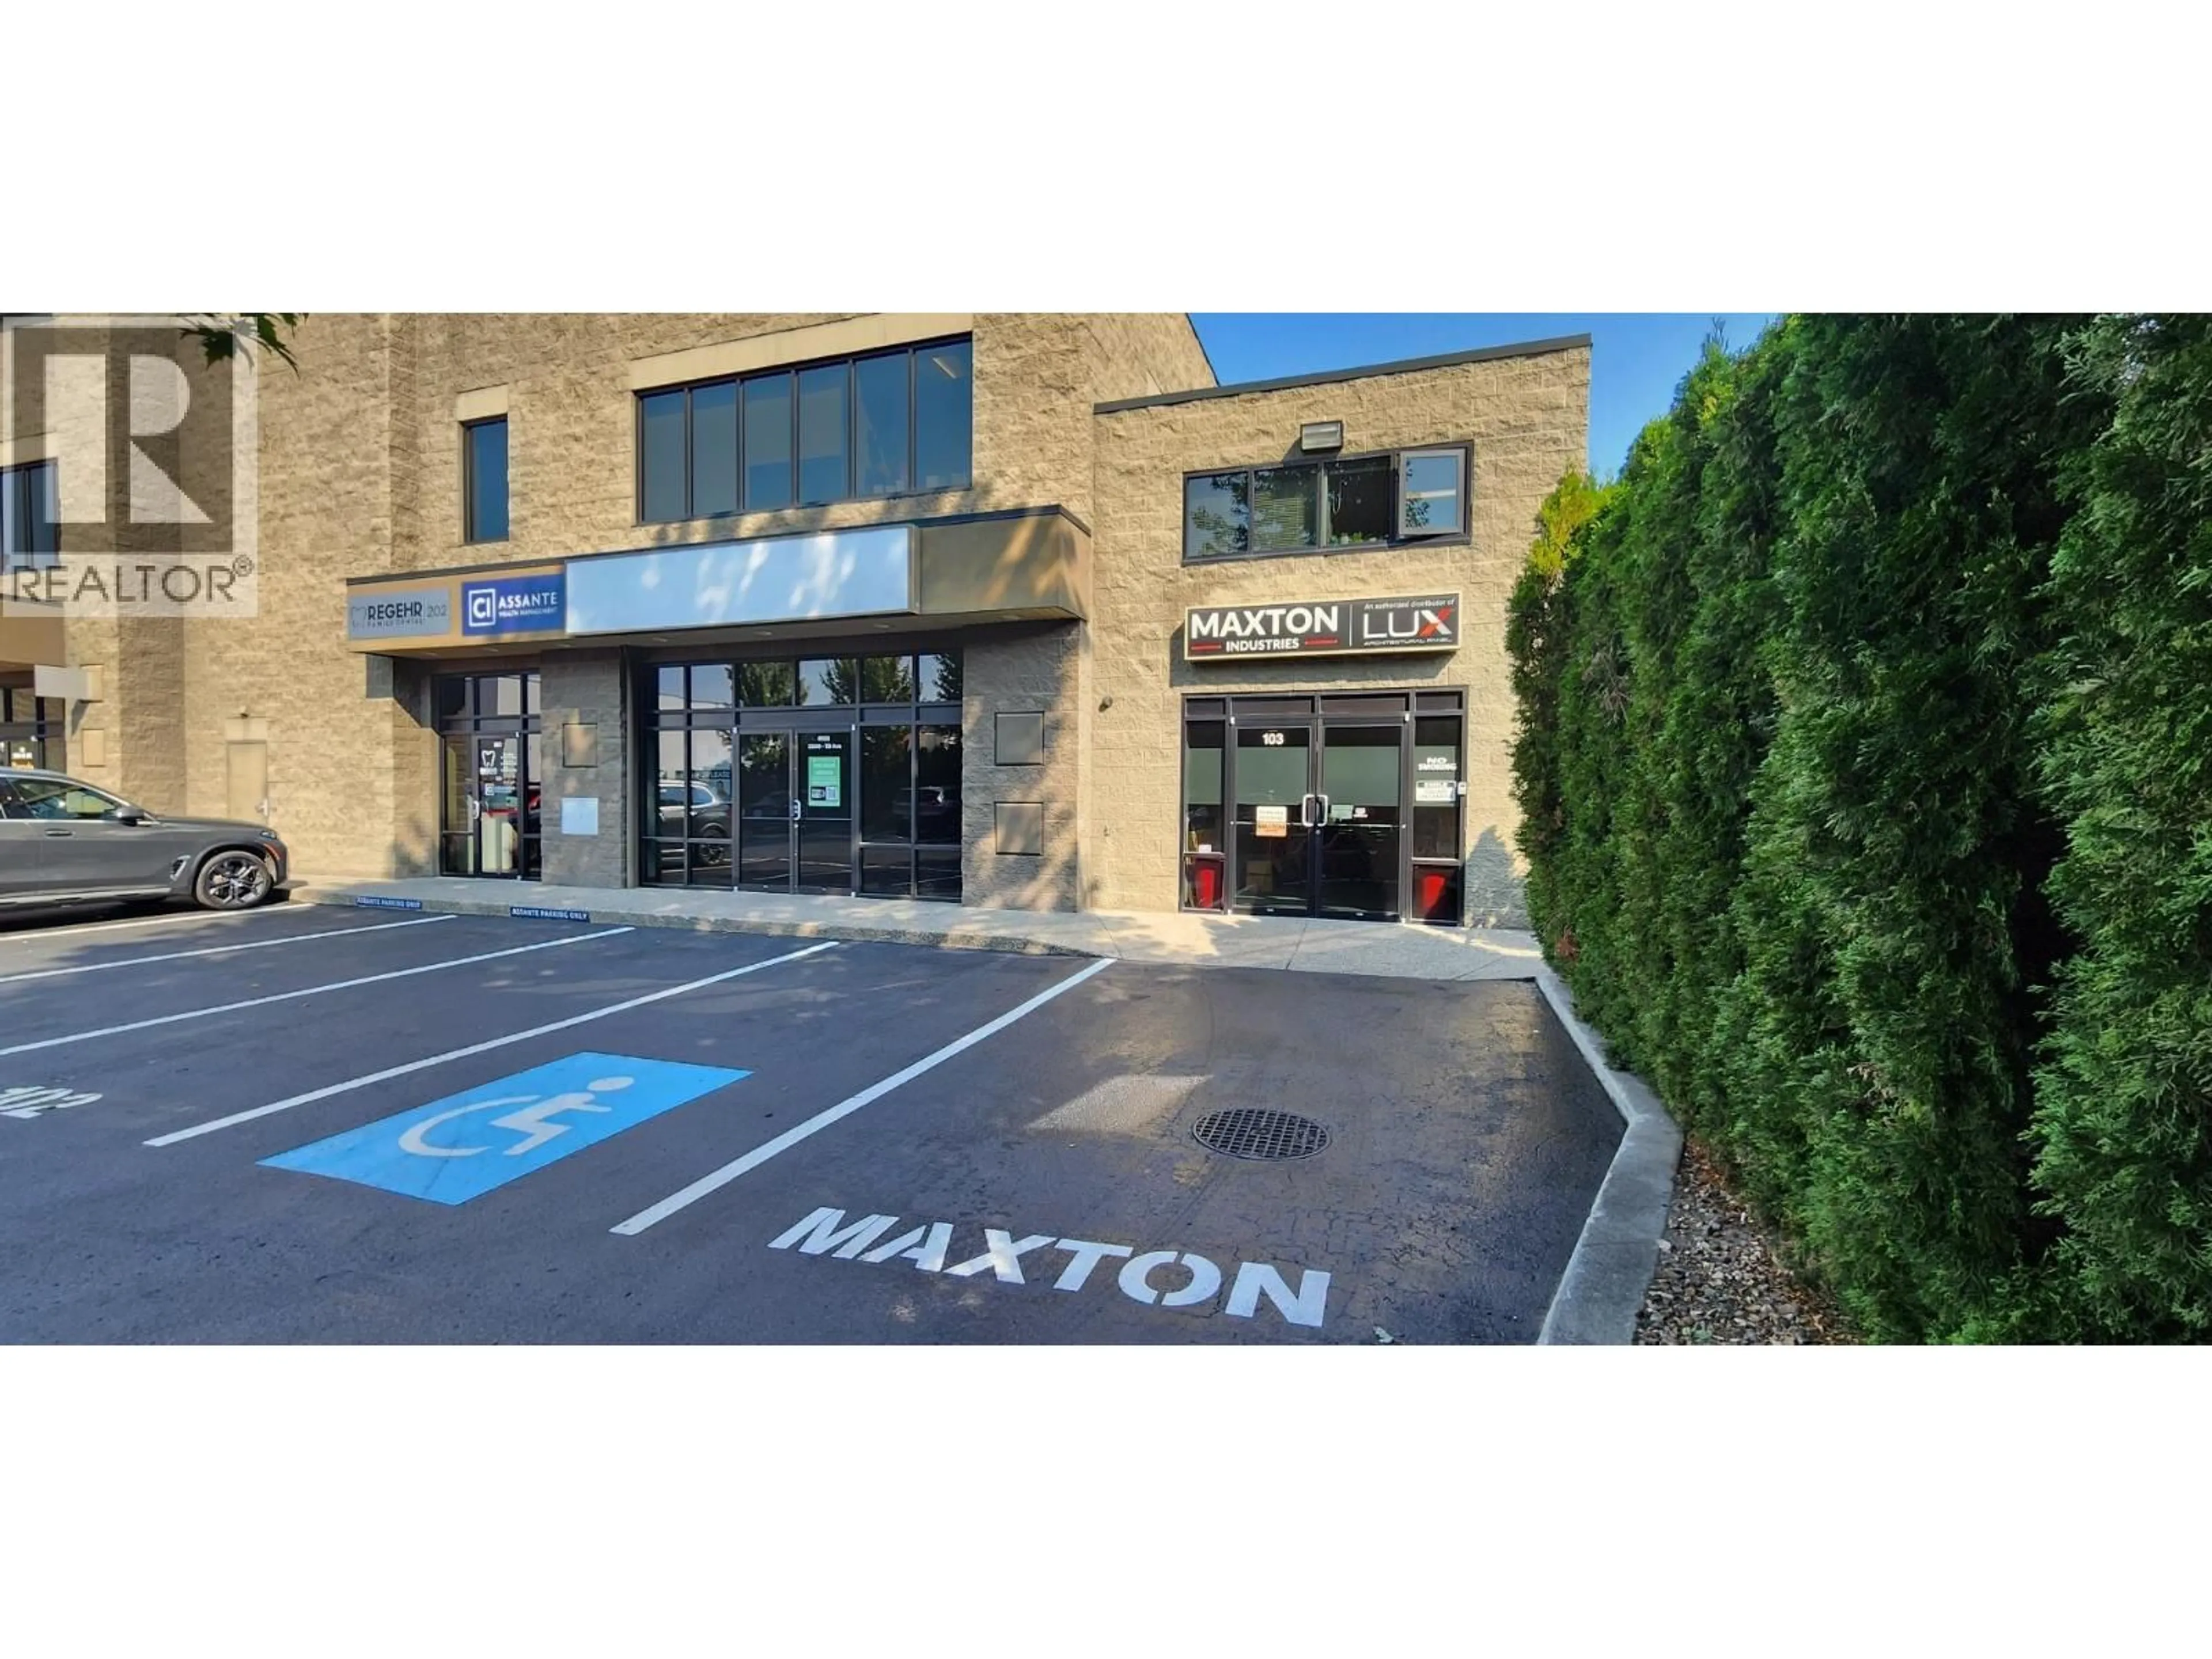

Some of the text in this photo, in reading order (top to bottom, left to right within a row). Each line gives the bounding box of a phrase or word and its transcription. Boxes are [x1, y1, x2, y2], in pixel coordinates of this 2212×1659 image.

[499, 592, 558, 609] ASSANTE
[368, 601, 423, 620] REGEHR
[427, 604, 447, 618] 202
[1191, 605, 1338, 639] MAXTON
[1363, 607, 1453, 639] LUX
[1226, 638, 1300, 652] INDUSTRIES
[1262, 732, 1285, 745] 103
[513, 908, 539, 916] ASSANTE
[540, 910, 569, 919] PARKING
[767, 1207, 1331, 1327] MAXTON
